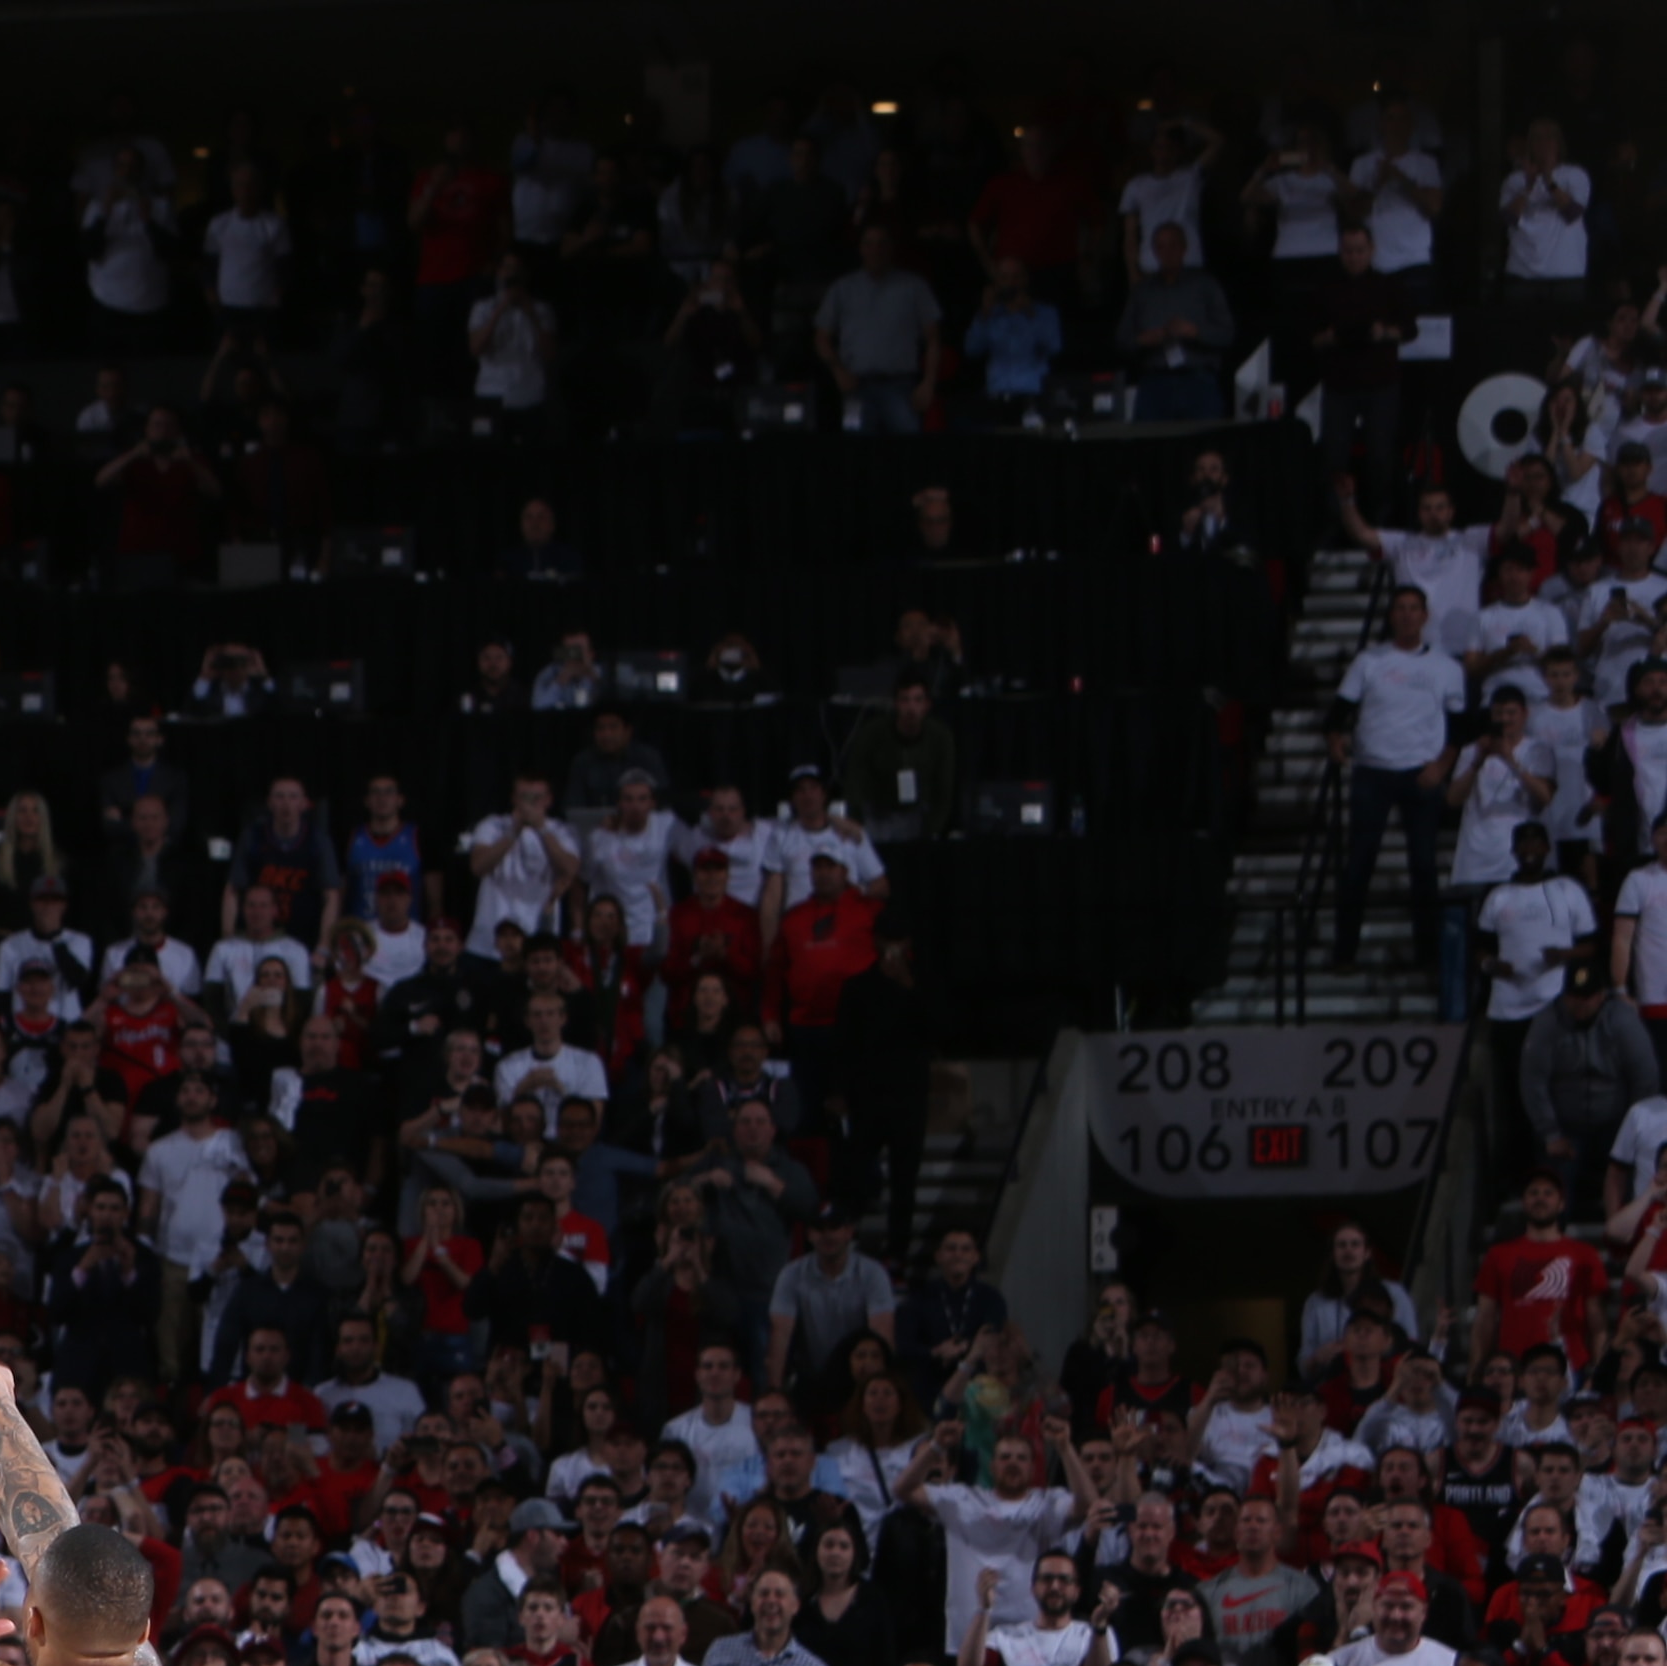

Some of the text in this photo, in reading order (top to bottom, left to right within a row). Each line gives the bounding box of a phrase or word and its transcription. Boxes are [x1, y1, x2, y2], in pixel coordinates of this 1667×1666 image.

[1118, 1037, 1439, 1093] 208 209
[1210, 1099, 1297, 1121] ENTRY
[1304, 1097, 1323, 1119] A
[1119, 1124, 1233, 1175] 106
[1253, 1127, 1302, 1164] EXIT
[1327, 1120, 1439, 1172] 107
